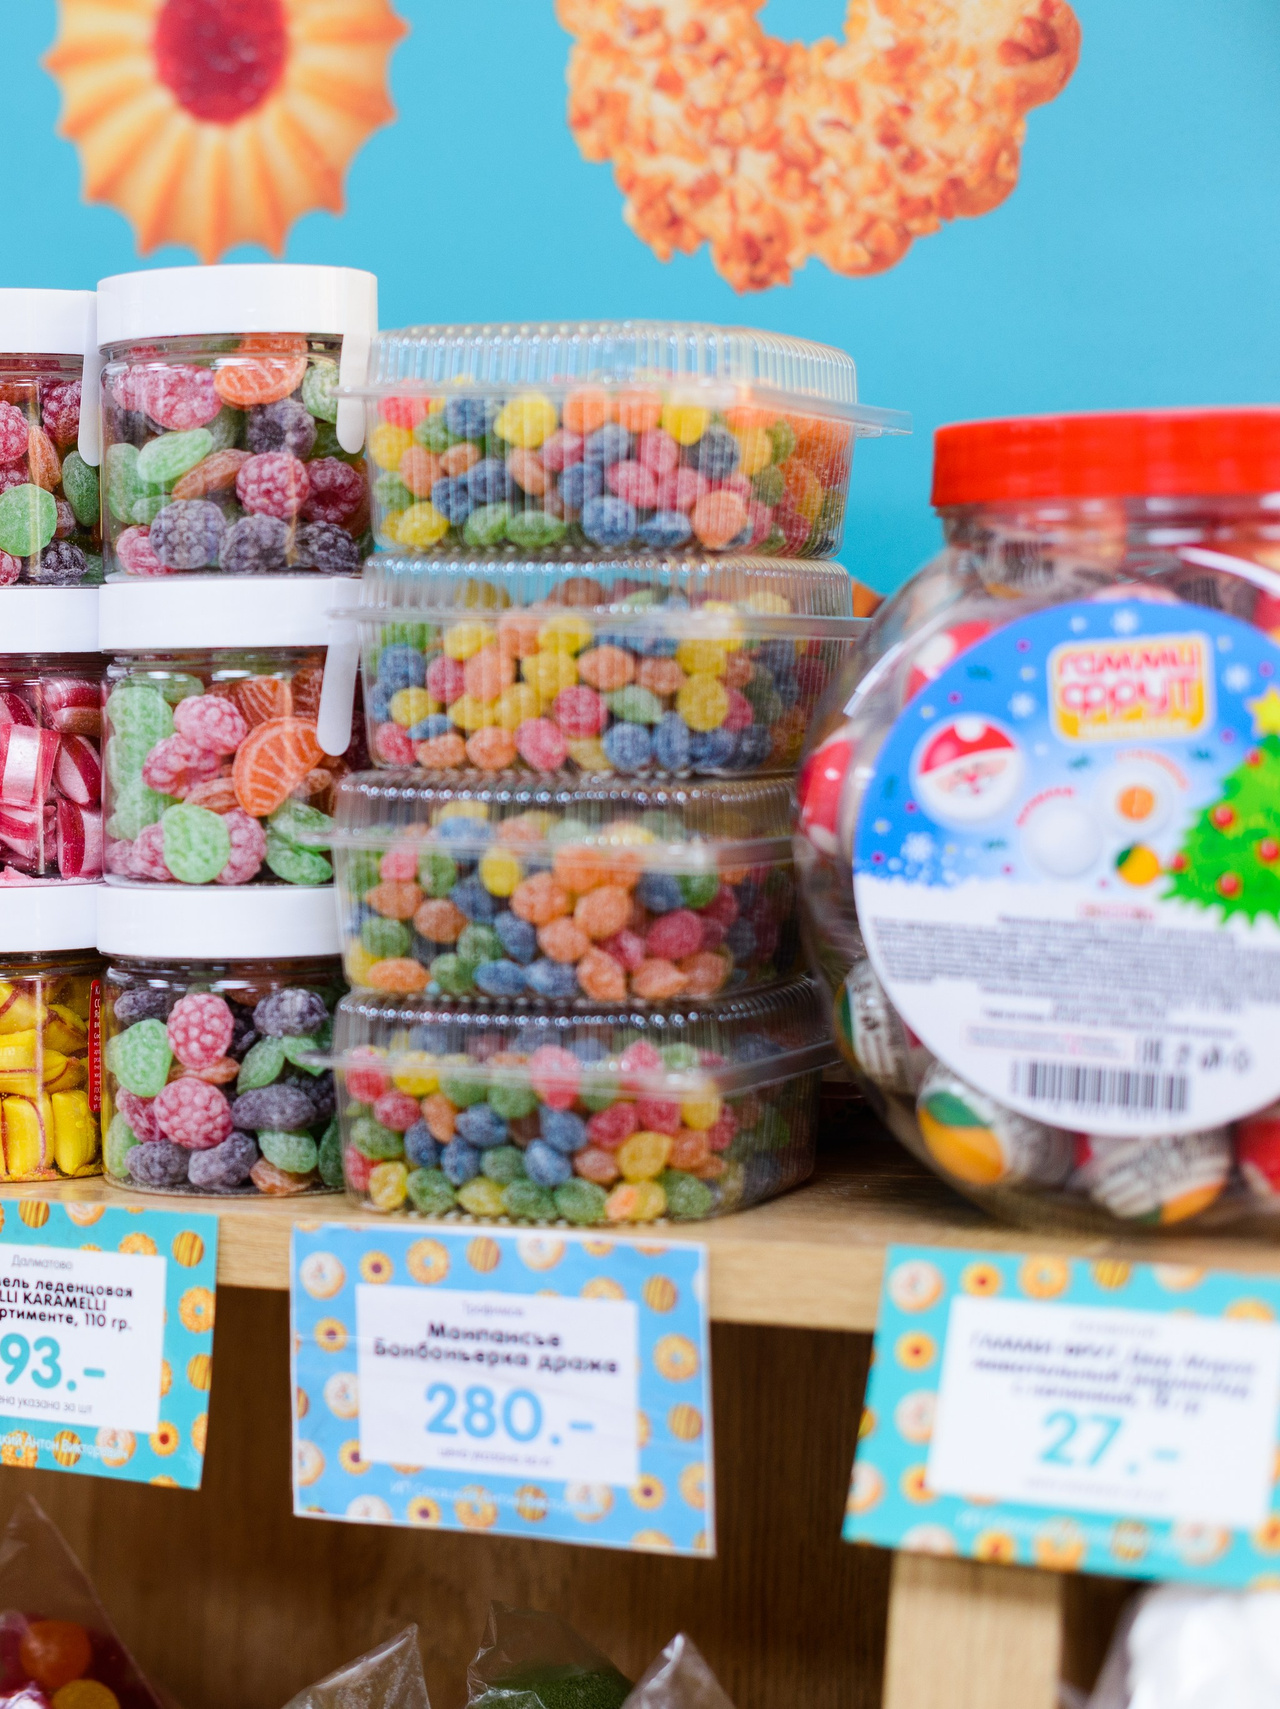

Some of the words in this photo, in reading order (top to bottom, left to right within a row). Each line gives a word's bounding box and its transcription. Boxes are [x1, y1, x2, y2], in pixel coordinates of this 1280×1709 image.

[35, 1278, 132, 1298] леденцовая
[23, 1292, 107, 1311] KARAMELLI
[85, 1313, 106, 1327] 110
[0, 1332, 106, 1392] 93.-
